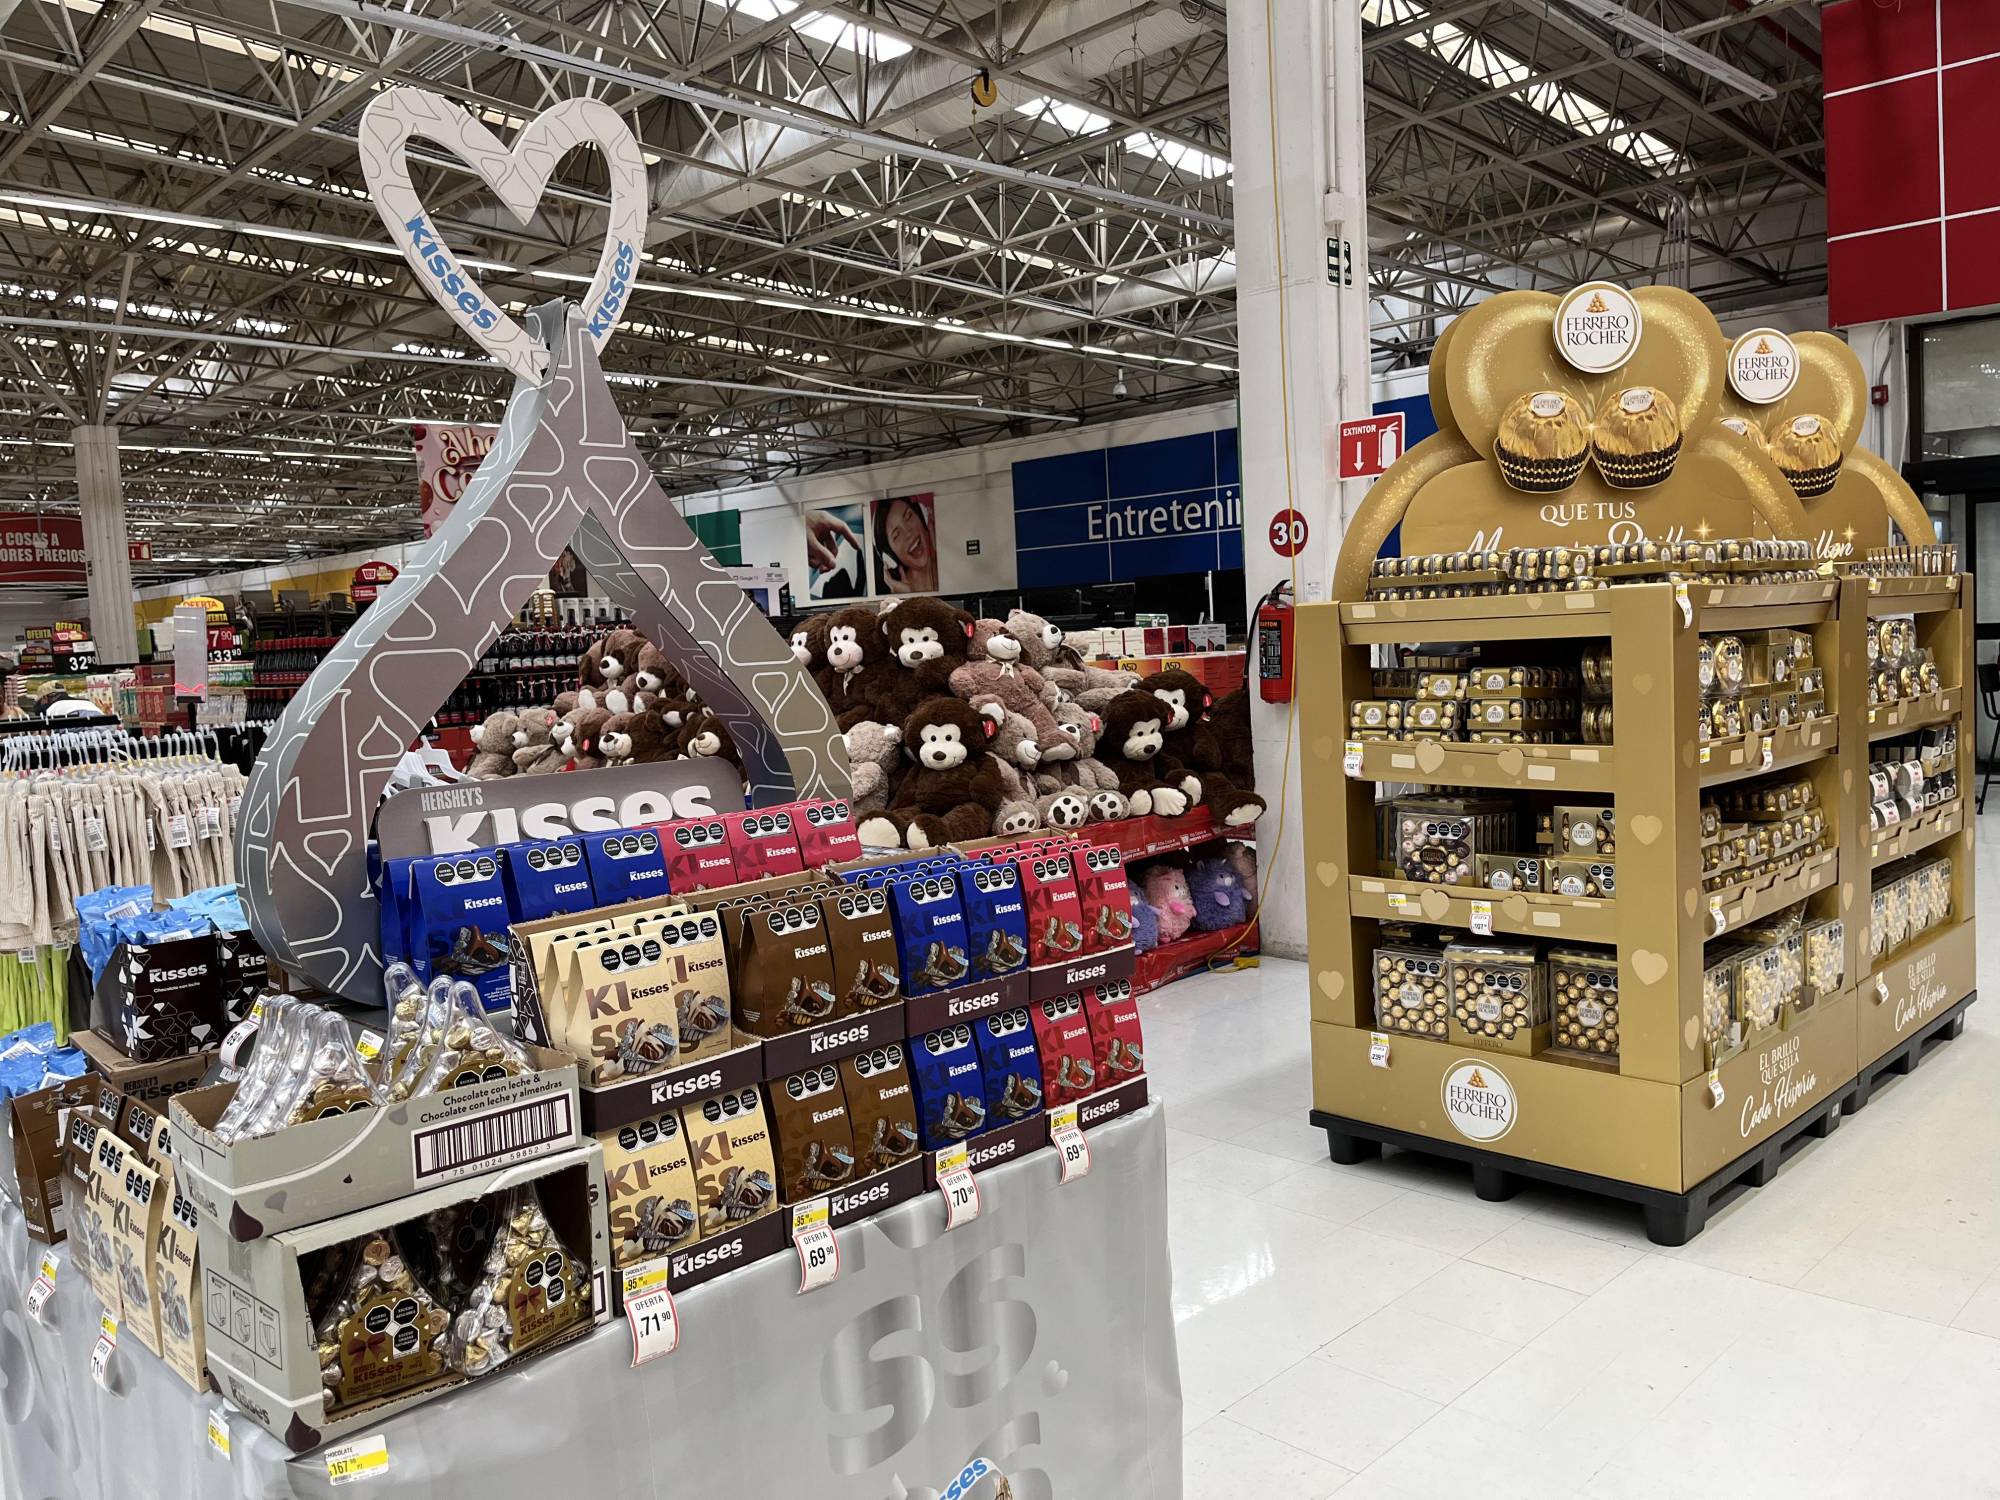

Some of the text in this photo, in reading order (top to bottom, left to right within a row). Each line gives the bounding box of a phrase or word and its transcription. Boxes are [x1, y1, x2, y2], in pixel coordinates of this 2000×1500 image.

[405, 216, 497, 329] Kisses
[587, 240, 634, 339] Kisses
[1566, 314, 1629, 332] FERRERO
[1566, 330, 1630, 347] ROCHER
[1738, 356, 1789, 369] FERRERO
[1738, 368, 1790, 381] ROCHER
[1343, 424, 1377, 437] EXTINTOR
[1087, 490, 1241, 541] Entreteni
[1540, 501, 1636, 527] QUE TUS
[51, 532, 60, 546] A
[1273, 520, 1305, 546] 30
[35, 549, 86, 562] PRECIOS
[69, 656, 88, 671] 32
[421, 786, 484, 812] HERSHEY'S
[829, 833, 857, 846] Kisses
[766, 846, 797, 858] Kisses
[699, 857, 731, 869] Kisses
[629, 868, 664, 882] Kisses
[554, 881, 588, 894] Kisses
[1104, 881, 1127, 892] Kisses
[464, 897, 503, 910] Kisses
[1053, 891, 1077, 902] Kisses
[995, 902, 1021, 915] Kisses
[933, 912, 961, 926] Kisses
[862, 929, 892, 943] Kisses
[794, 944, 827, 959] Kisses
[149, 964, 208, 983] Kisses
[688, 957, 723, 973] Kisses
[1067, 964, 1106, 984] Kisses
[585, 981, 670, 1020] KI Kisses
[948, 992, 999, 1016] Kisses
[1114, 1012, 1137, 1024] Kisses
[810, 1024, 869, 1054] Kisses
[1063, 1026, 1087, 1040] Kisses
[1009, 1044, 1035, 1059] Kisses
[1760, 1036, 1799, 1071] EL BRILLO
[949, 1061, 977, 1077] Kisses
[1761, 1052, 1800, 1085] QUE SELLA
[443, 1073, 541, 1107] Chocolate con leche &
[651, 1070, 722, 1104] Kisses
[879, 1083, 909, 1100] Kisses
[420, 1080, 563, 1124] Chocolate con leche y almendras
[1450, 1084, 1507, 1109] FERRERO
[1740, 1068, 1817, 1138] Cada Historia
[812, 1106, 845, 1124] Kisses
[1082, 1099, 1120, 1123] Kisses
[1450, 1098, 1507, 1123] ROCHER
[1060, 1131, 1079, 1143] OFERTA
[690, 1130, 766, 1171] KI Kisses
[967, 1138, 1016, 1167] Kisses
[453, 1168, 465, 1176] 75
[473, 1157, 503, 1171] 01024
[510, 1146, 539, 1161] 59852
[607, 1158, 687, 1198] KI Kisses
[946, 1173, 968, 1186] OFERTA
[831, 1182, 890, 1217] Kisses
[803, 1231, 828, 1245] OFERTA
[672, 1238, 743, 1278] Kisses
[808, 1245, 834, 1269] $69 90
[635, 1295, 664, 1311] OFERTA
[520, 1311, 555, 1336] Kisses
[640, 1310, 671, 1338] $71 90
[353, 1361, 403, 1384] Kisses
